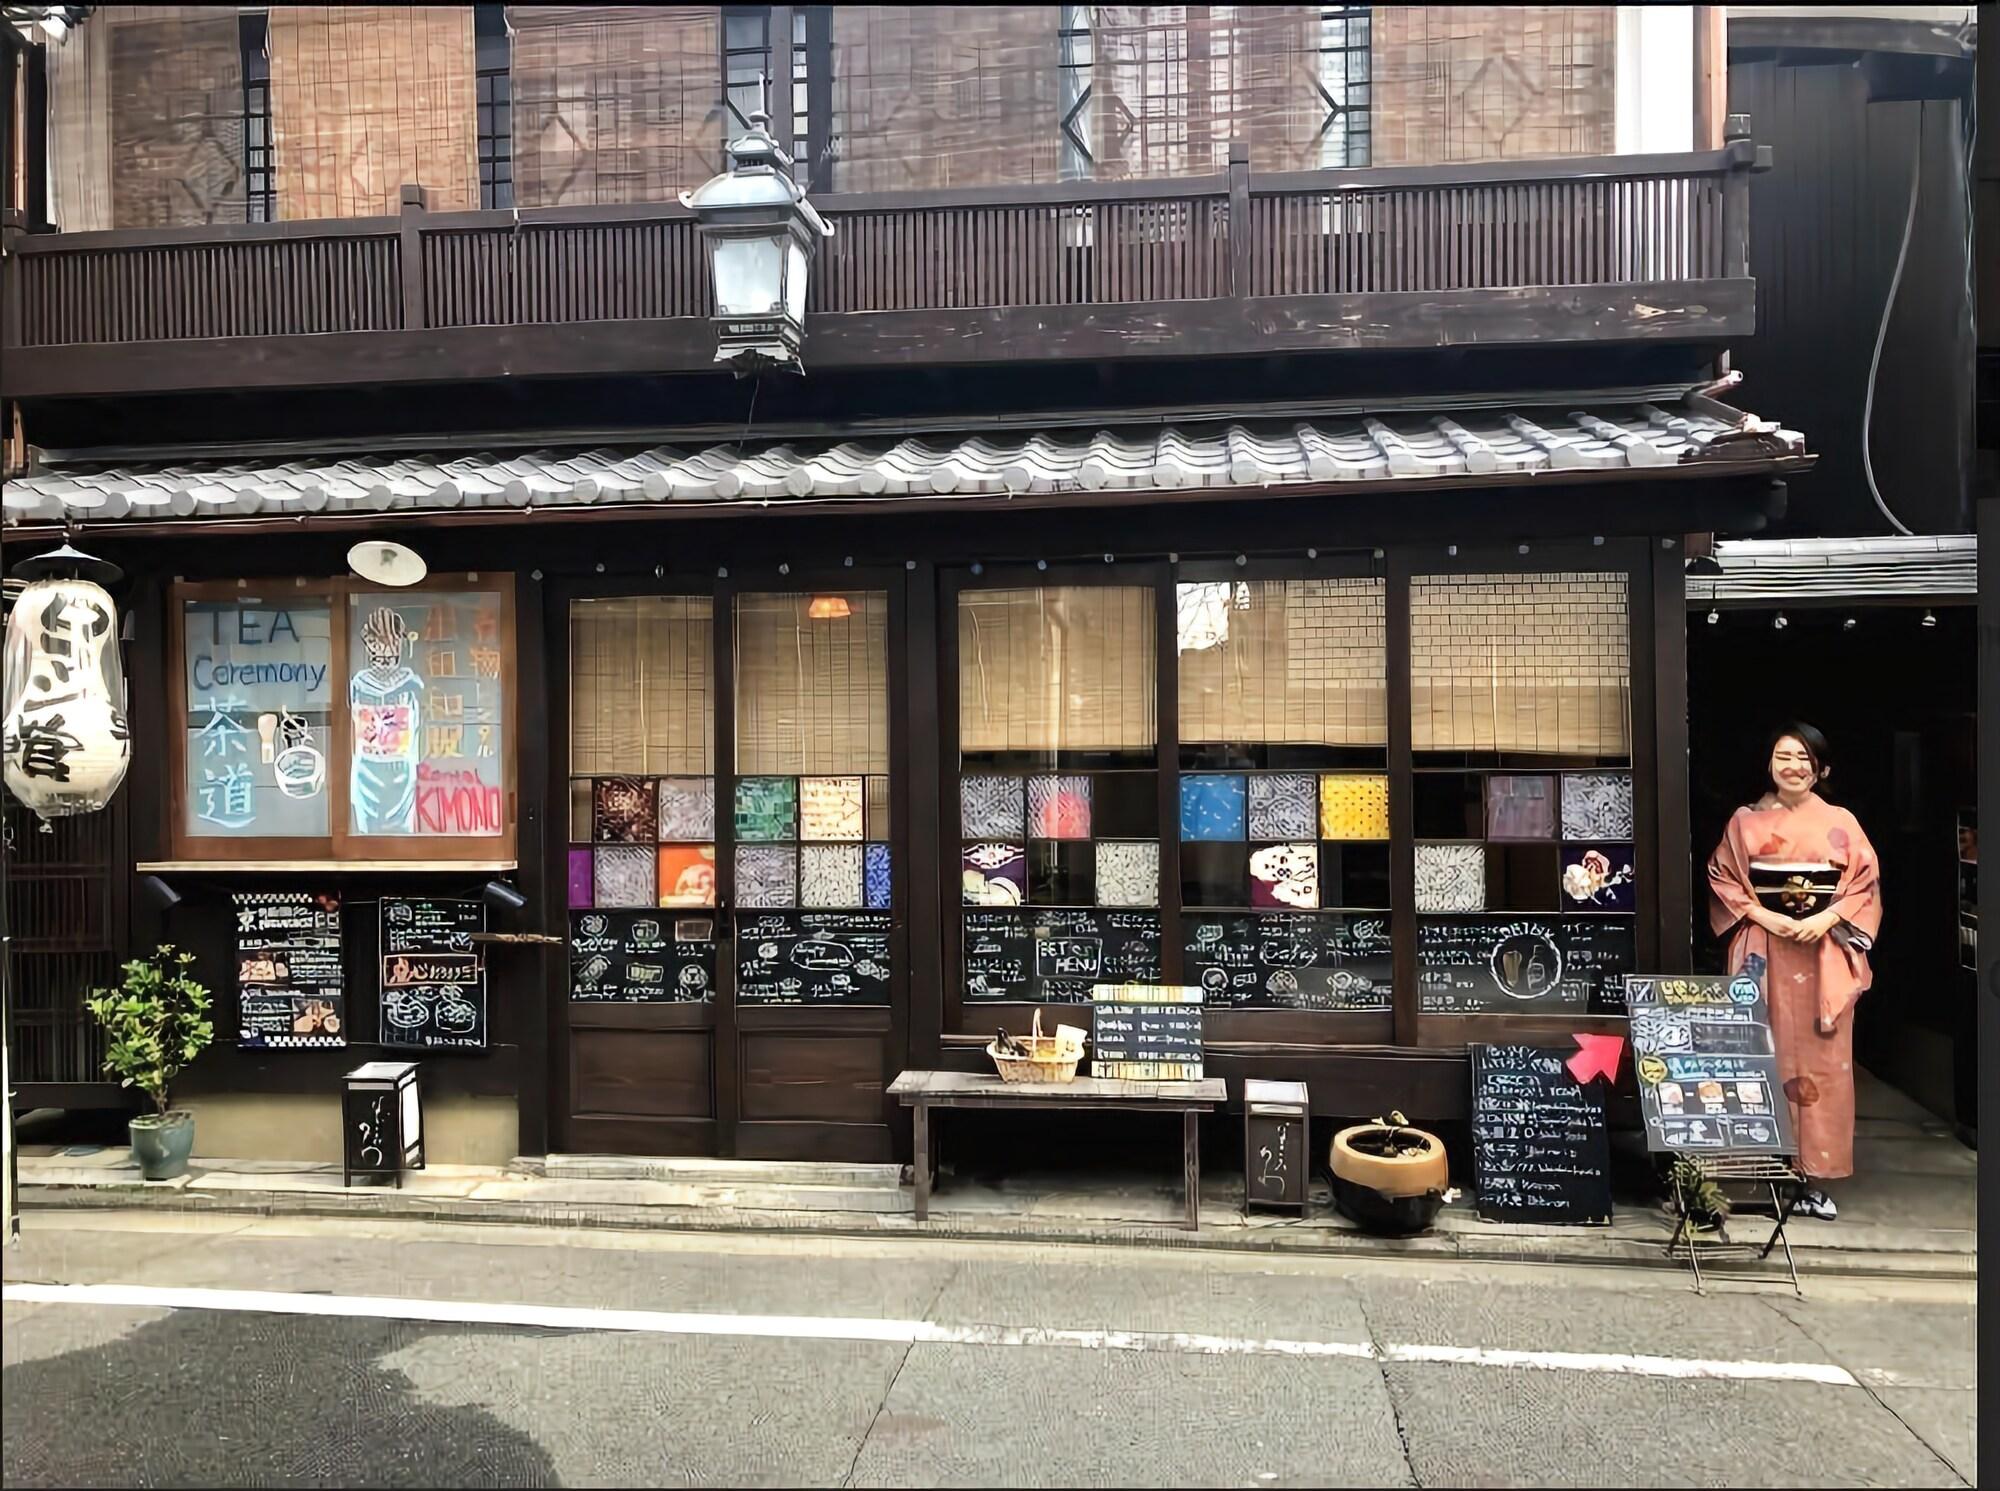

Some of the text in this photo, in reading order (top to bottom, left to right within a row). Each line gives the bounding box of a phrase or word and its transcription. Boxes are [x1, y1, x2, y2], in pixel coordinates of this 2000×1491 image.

[210, 609, 299, 644] TEA
[193, 656, 326, 691] Ceremony
[194, 694, 256, 828] 茶道
[416, 785, 501, 833] KIMONO
